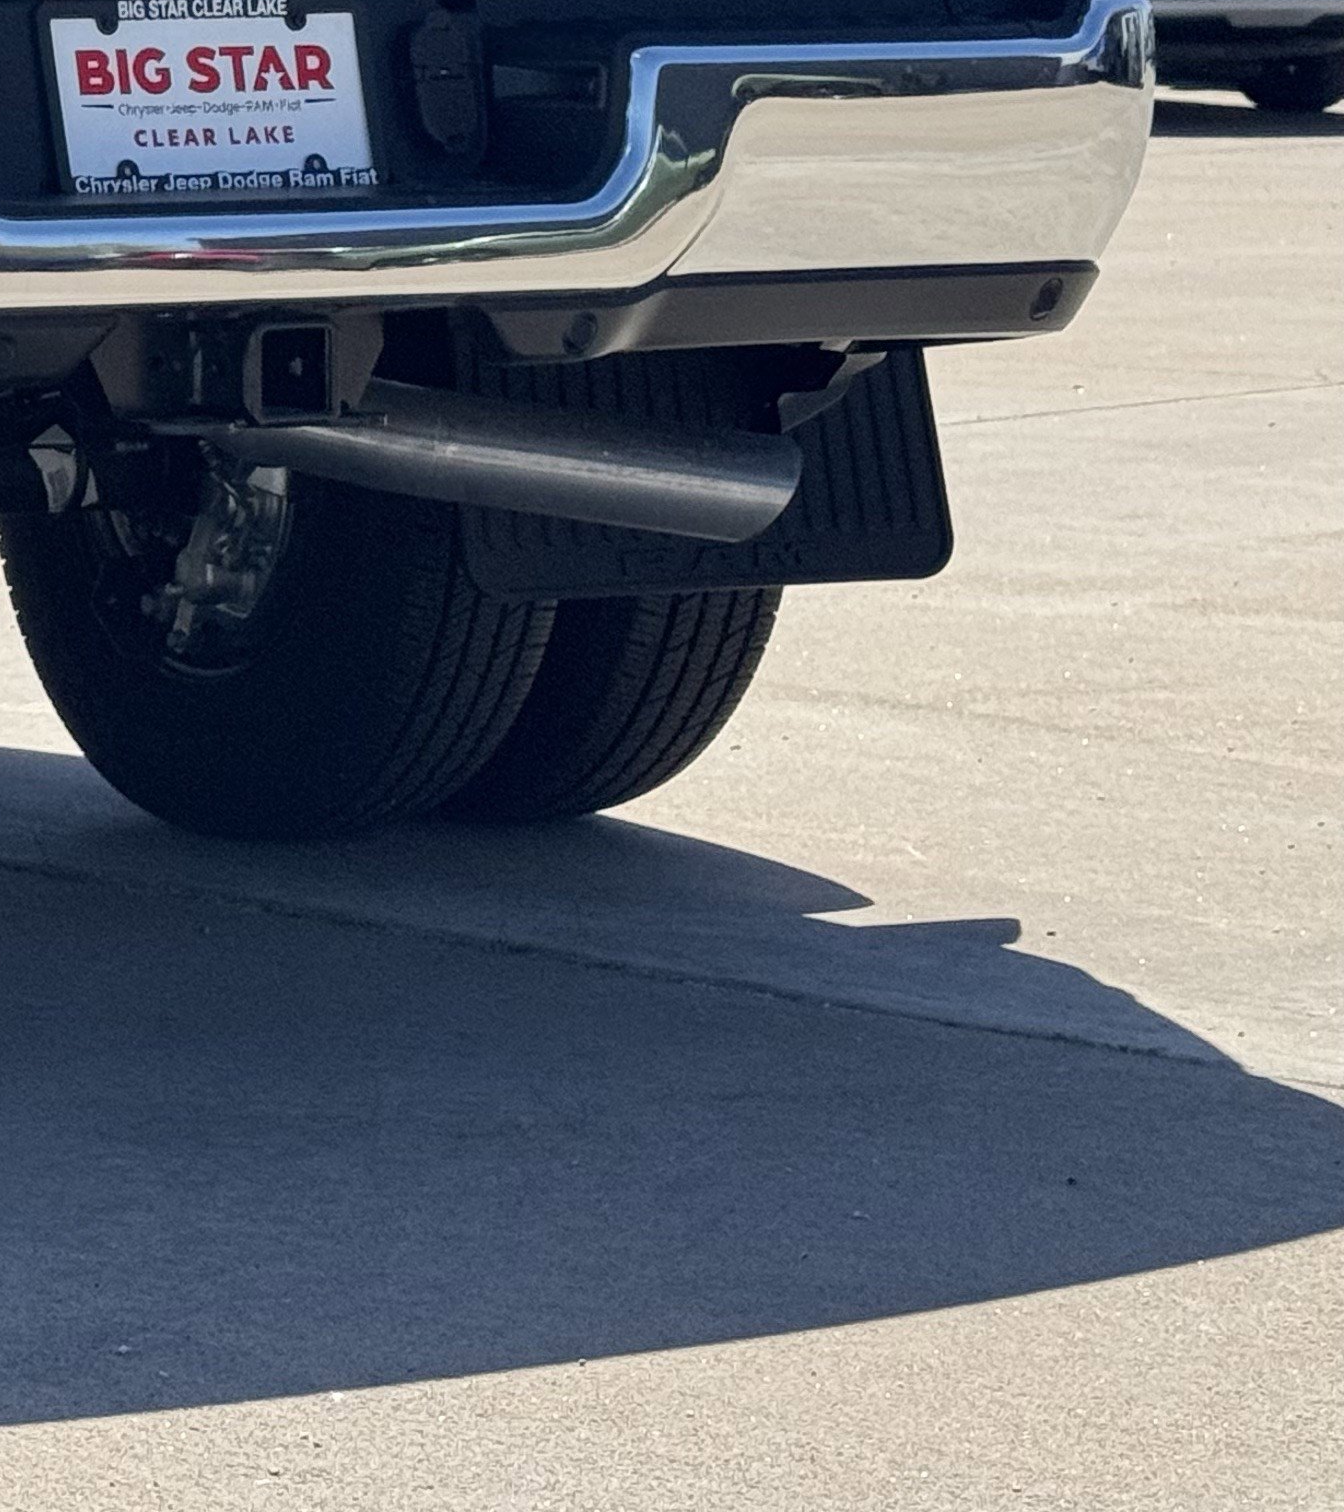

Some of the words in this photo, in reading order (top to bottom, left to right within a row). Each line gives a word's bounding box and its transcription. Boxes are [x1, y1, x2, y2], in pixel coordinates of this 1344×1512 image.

[117, 0, 146, 19] BIG
[74, 47, 172, 95] BIG
[185, 44, 336, 93] STAR
[133, 128, 217, 148] CLEAR
[228, 125, 296, 145] LAKE
[75, 175, 158, 195] Chrysler
[164, 173, 212, 191] Jeep
[218, 171, 283, 190] Dodge
[288, 169, 335, 187] Ram
[339, 167, 378, 186] Fiat
